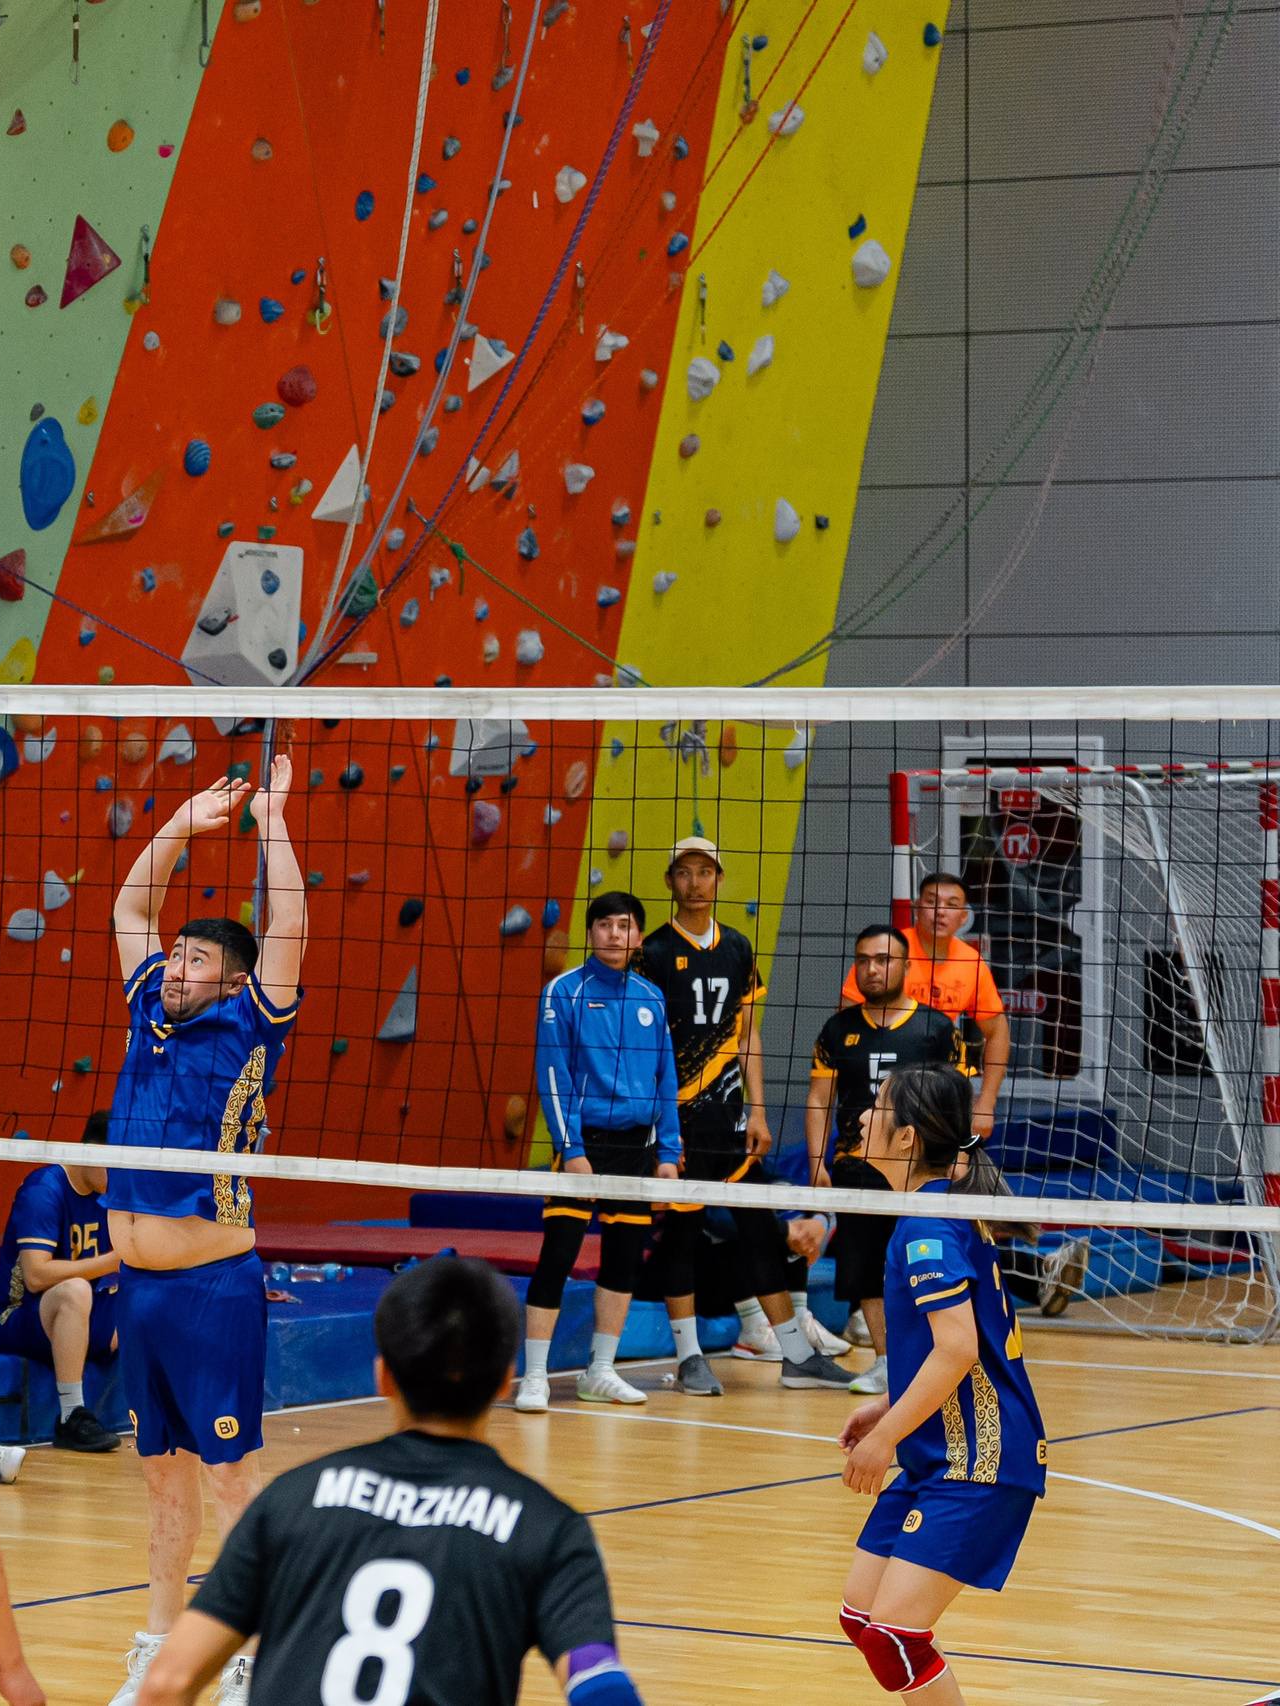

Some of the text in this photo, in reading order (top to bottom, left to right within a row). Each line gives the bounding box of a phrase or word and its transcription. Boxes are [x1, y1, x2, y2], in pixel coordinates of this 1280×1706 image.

[692, 977, 729, 1024] 17
[219, 1420, 234, 1434] BI
[312, 1466, 524, 1544] MEIRZHAN
[905, 1514, 918, 1527] BI
[320, 1558, 435, 1706] 8
